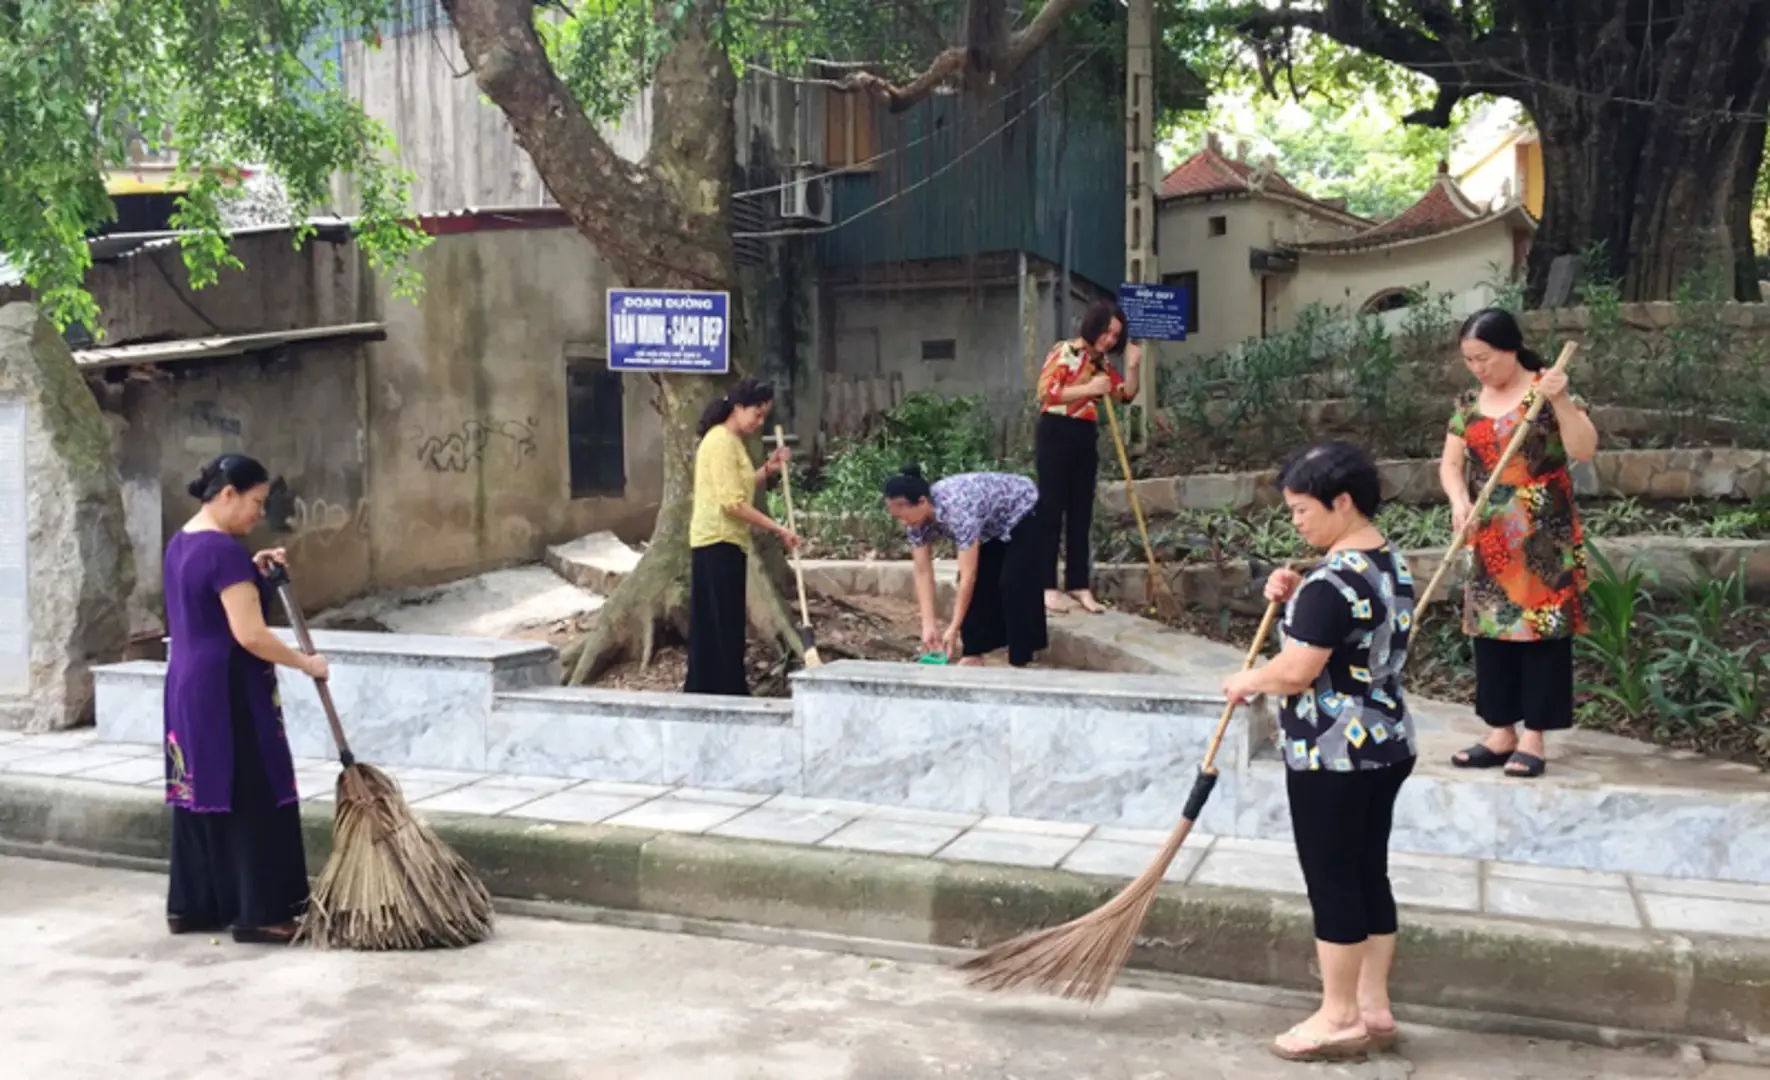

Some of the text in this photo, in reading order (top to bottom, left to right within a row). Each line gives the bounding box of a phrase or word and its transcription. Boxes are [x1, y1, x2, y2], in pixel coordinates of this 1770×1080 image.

[624, 294, 713, 311] ĐOẠN ĐƯỜNG
[702, 316, 724, 352] ĐẸP
